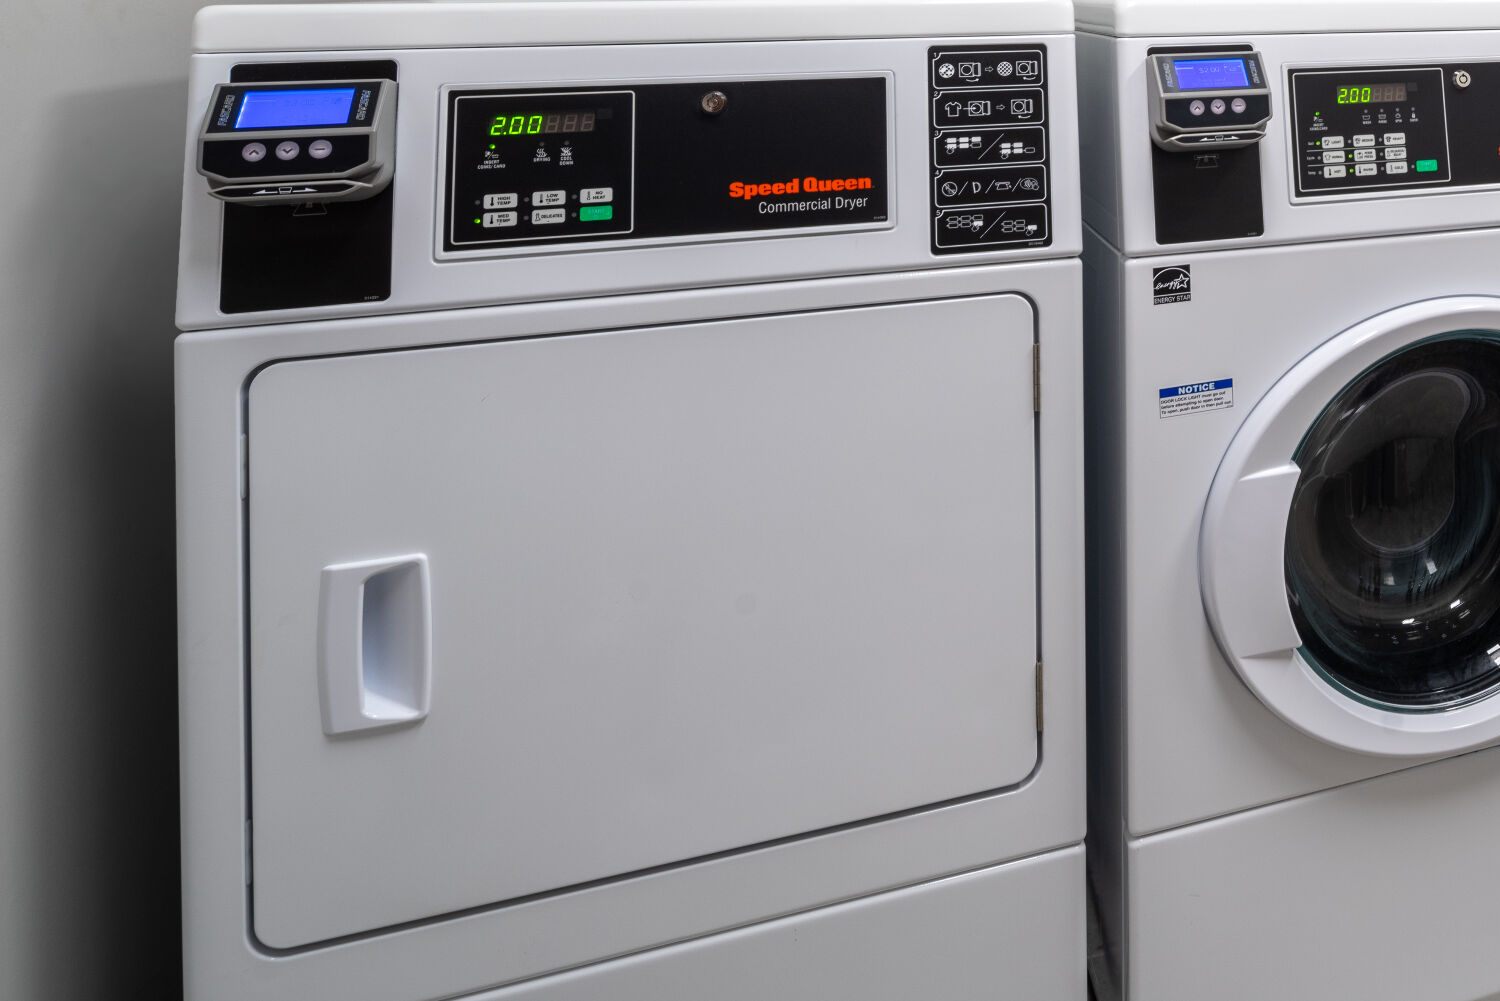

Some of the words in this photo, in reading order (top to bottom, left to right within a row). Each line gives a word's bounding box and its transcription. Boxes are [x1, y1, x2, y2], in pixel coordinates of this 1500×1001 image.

[1338, 88, 1371, 104] 2.00
[490, 116, 542, 136] 2.00
[729, 179, 799, 200] Speed
[803, 176, 872, 193] Queen
[759, 198, 831, 215] Commercial
[834, 196, 868, 211] Dryer
[1178, 383, 1215, 394] NOTICE
